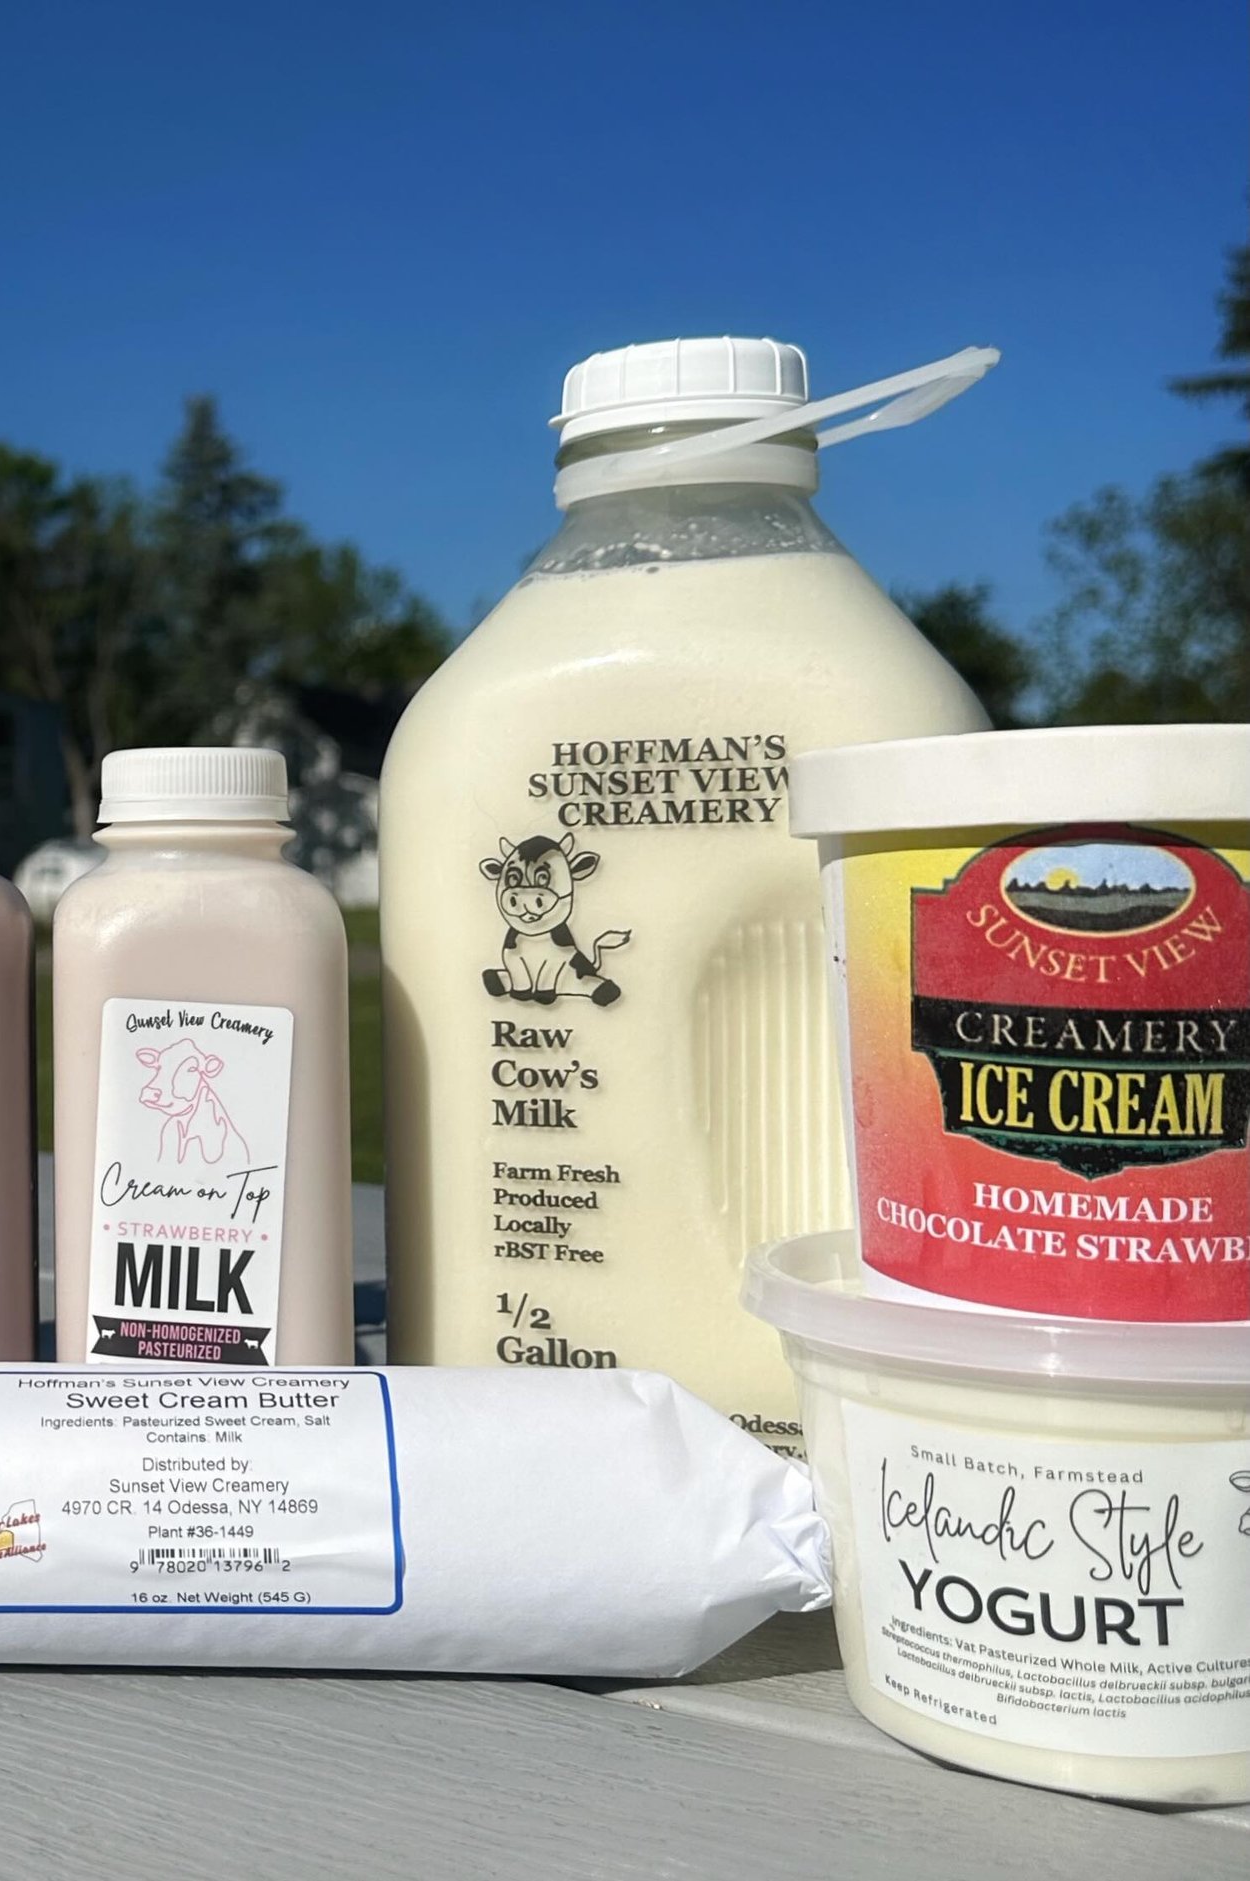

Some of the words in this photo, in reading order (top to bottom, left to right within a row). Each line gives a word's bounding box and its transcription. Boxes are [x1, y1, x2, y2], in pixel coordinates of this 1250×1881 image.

[552, 734, 786, 767] HOFFMAN'S
[528, 769, 679, 798] SUNSET
[558, 798, 782, 828] CREAMERY
[965, 904, 1116, 984] SUNSET
[1122, 905, 1224, 980] VIEW
[126, 1009, 173, 1032] Sunset
[178, 1010, 204, 1027] View
[211, 1012, 274, 1045] Creamery
[490, 1021, 574, 1049] Raw
[955, 1010, 1239, 1052] CREAMERY
[491, 1060, 599, 1090] Cow's
[960, 1062, 1034, 1129] ICE
[1049, 1070, 1224, 1136] CREAM
[492, 1099, 578, 1129] Milk
[493, 1162, 551, 1181] Farm
[557, 1164, 621, 1184] Fresh
[101, 1162, 192, 1207] Cream
[197, 1189, 227, 1200] on
[226, 1165, 278, 1224] Top
[493, 1189, 599, 1210] Produced
[972, 1182, 1212, 1224] HOMEMADE
[117, 1221, 253, 1243] STRAWBERRY
[494, 1215, 572, 1238] Locally
[877, 1196, 1067, 1258] CHOCOLATE
[494, 1243, 549, 1259] rBST
[554, 1244, 604, 1263] Free
[115, 1242, 255, 1314] MILK
[120, 1321, 241, 1344] NON-HOMOGENIZED
[138, 1341, 221, 1360] PASTEURIZED
[496, 1336, 617, 1368] Gallon
[18, 1378, 116, 1389] Hoffman's
[123, 1377, 192, 1388] Sunset
[197, 1377, 245, 1388] View
[251, 1377, 350, 1389] Creamery
[66, 1393, 149, 1410] Sweet
[159, 1392, 248, 1409] Cream
[259, 1392, 340, 1408] Butter
[123, 1416, 201, 1427] Pasteurized
[204, 1416, 246, 1427] Sweet
[250, 1416, 300, 1428] Cream,
[305, 1415, 331, 1426] Salt
[215, 1431, 242, 1443] Milk
[142, 1458, 225, 1472] Distributed
[911, 1445, 957, 1467] Small
[964, 1457, 1025, 1480] Batch,
[1034, 1466, 1144, 1484] Farmstead
[110, 1479, 165, 1494] Sunset
[169, 1479, 207, 1493] View
[212, 1479, 289, 1495] Creamery
[6, 1513, 41, 1527] Lakes
[61, 1501, 102, 1515] 4970
[143, 1500, 163, 1514] 14
[168, 1500, 233, 1517] Odessa,
[239, 1500, 263, 1514] NY
[268, 1500, 318, 1514] 14869
[148, 1526, 183, 1538] Plant
[186, 1525, 254, 1538] #36-1449
[881, 1457, 1055, 1564] Icelandic
[1069, 1488, 1204, 1596] Style
[132, 1593, 148, 1603] 16
[178, 1592, 201, 1603] Net
[204, 1591, 253, 1605] Weight
[258, 1591, 290, 1605] (545
[294, 1591, 311, 1605] G)
[898, 1558, 1184, 1647] YOGURT
[882, 1626, 941, 1658] Streptococcus
[942, 1652, 1014, 1678] thermophilus,
[1017, 1670, 1096, 1688] Lactobacillus
[1100, 1680, 1167, 1690] delbrueckii
[955, 1638, 976, 1653] Vat
[979, 1644, 1057, 1668] Pasteurized
[1060, 1658, 1106, 1672] Whole
[1110, 1662, 1143, 1675] Milk,
[1147, 1663, 1192, 1674] Active
[885, 1674, 910, 1696] Keep
[914, 1688, 998, 1725] Refrigerated
[997, 1693, 1089, 1716] Bifidobacterium
[1093, 1708, 1126, 1718] lactis
